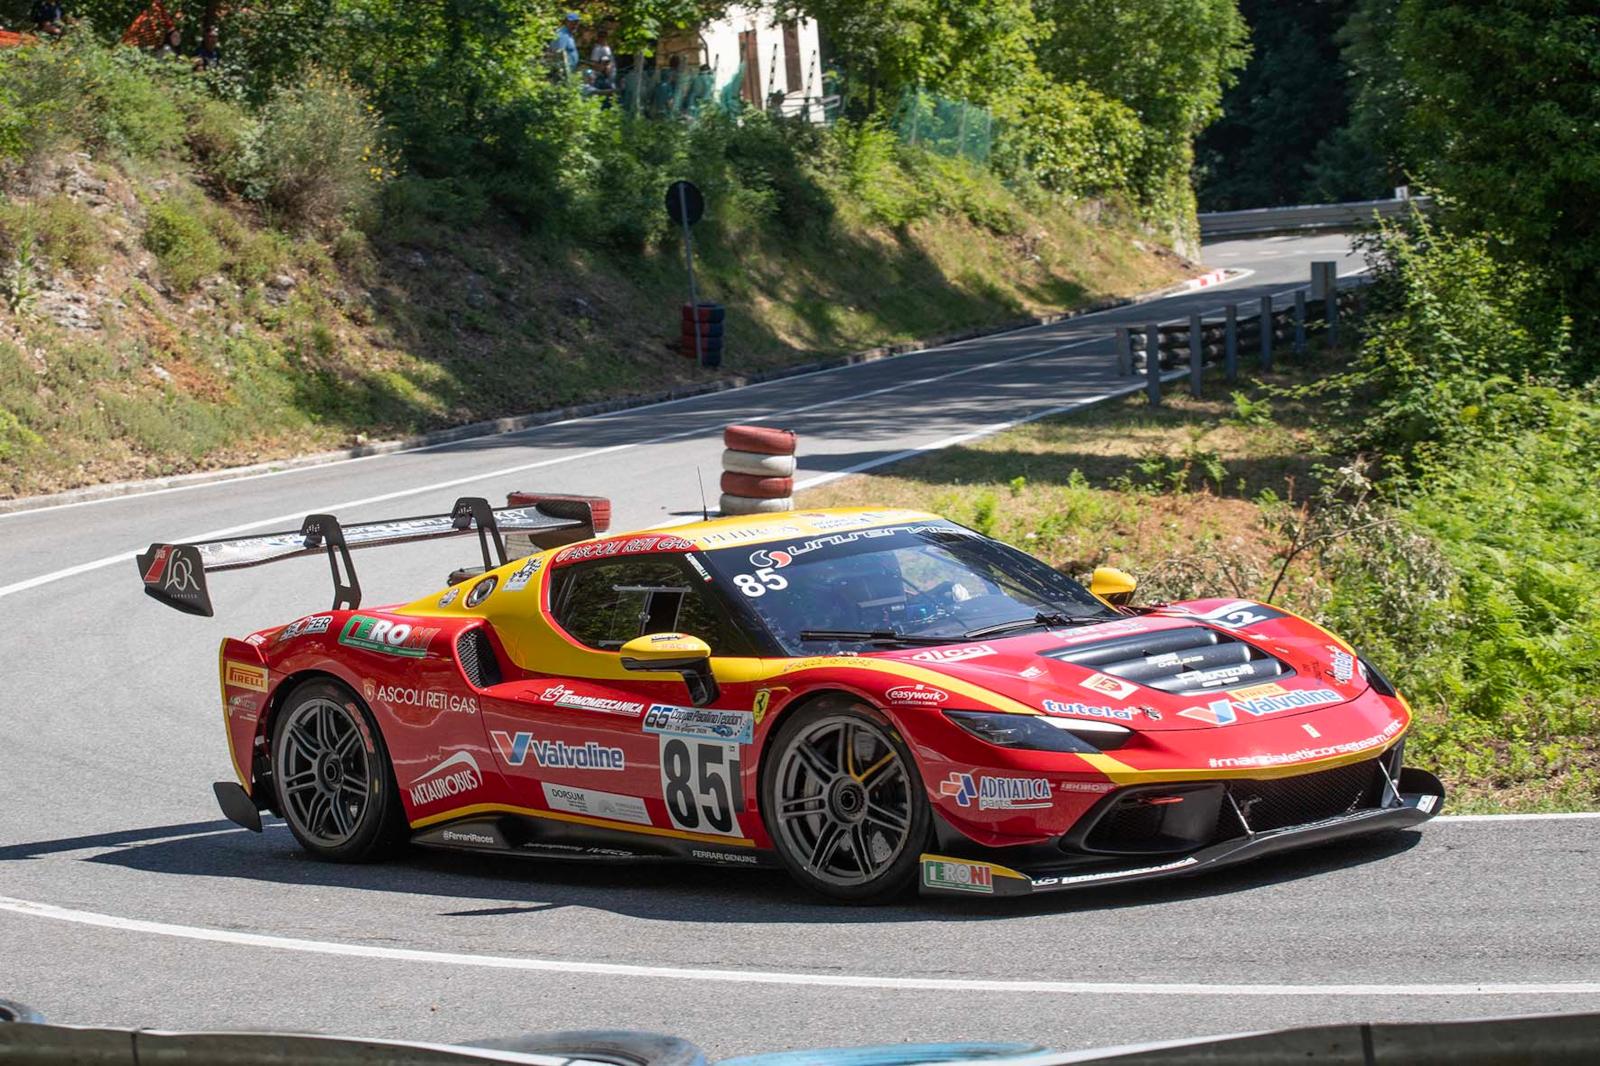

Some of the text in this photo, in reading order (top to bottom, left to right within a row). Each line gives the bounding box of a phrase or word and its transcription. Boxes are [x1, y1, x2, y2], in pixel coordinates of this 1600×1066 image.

[733, 567, 788, 597] 85
[230, 666, 264, 689] PIRELLI
[377, 685, 476, 714] ASCOLI RETI GAS
[558, 690, 645, 714] TERMOMECCANICA
[890, 690, 941, 701] easywork
[1234, 689, 1342, 716] Valvoline
[645, 706, 673, 729] 65
[671, 709, 743, 725] Coppa Paolino Teodori
[1043, 699, 1132, 720] tutela
[530, 740, 625, 771] Valvoline
[409, 770, 478, 806] METAUROBUS
[551, 788, 586, 801] DORSUM
[663, 738, 733, 833] 85
[979, 776, 1052, 799] ADRIATICA
[980, 799, 1012, 810] parts
[692, 850, 757, 864] FERRARI GENUINE
